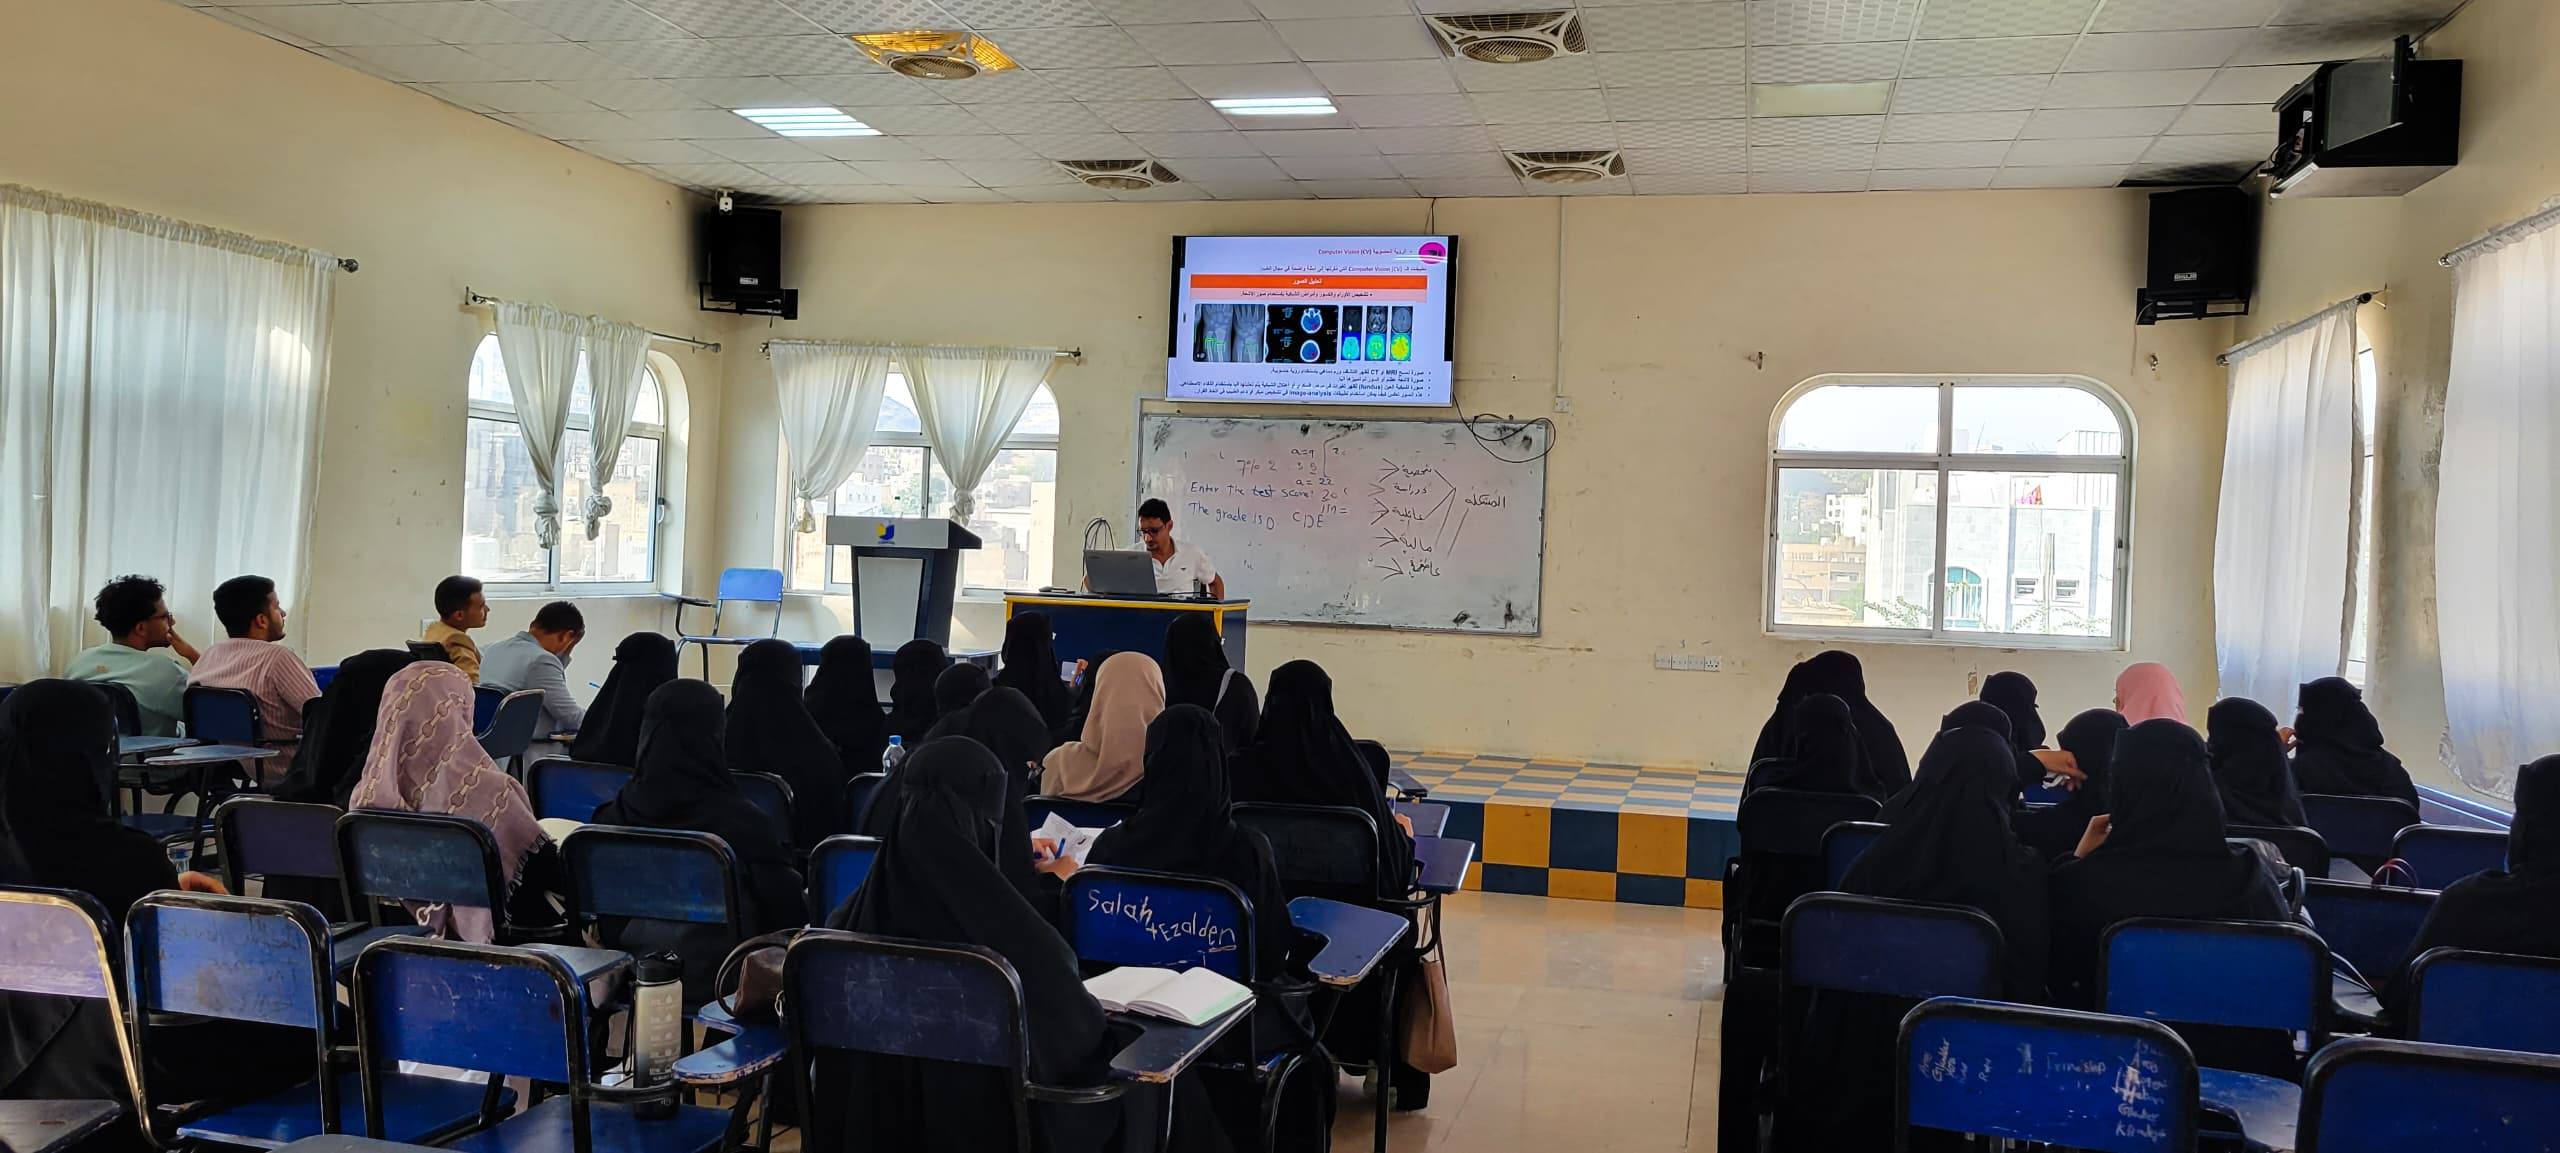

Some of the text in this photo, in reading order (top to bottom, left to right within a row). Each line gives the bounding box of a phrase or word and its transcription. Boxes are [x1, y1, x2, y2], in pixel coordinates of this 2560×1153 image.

[1252, 484, 1277, 498] test
[1188, 502, 1209, 516] The
[1215, 506, 1247, 522] grade
